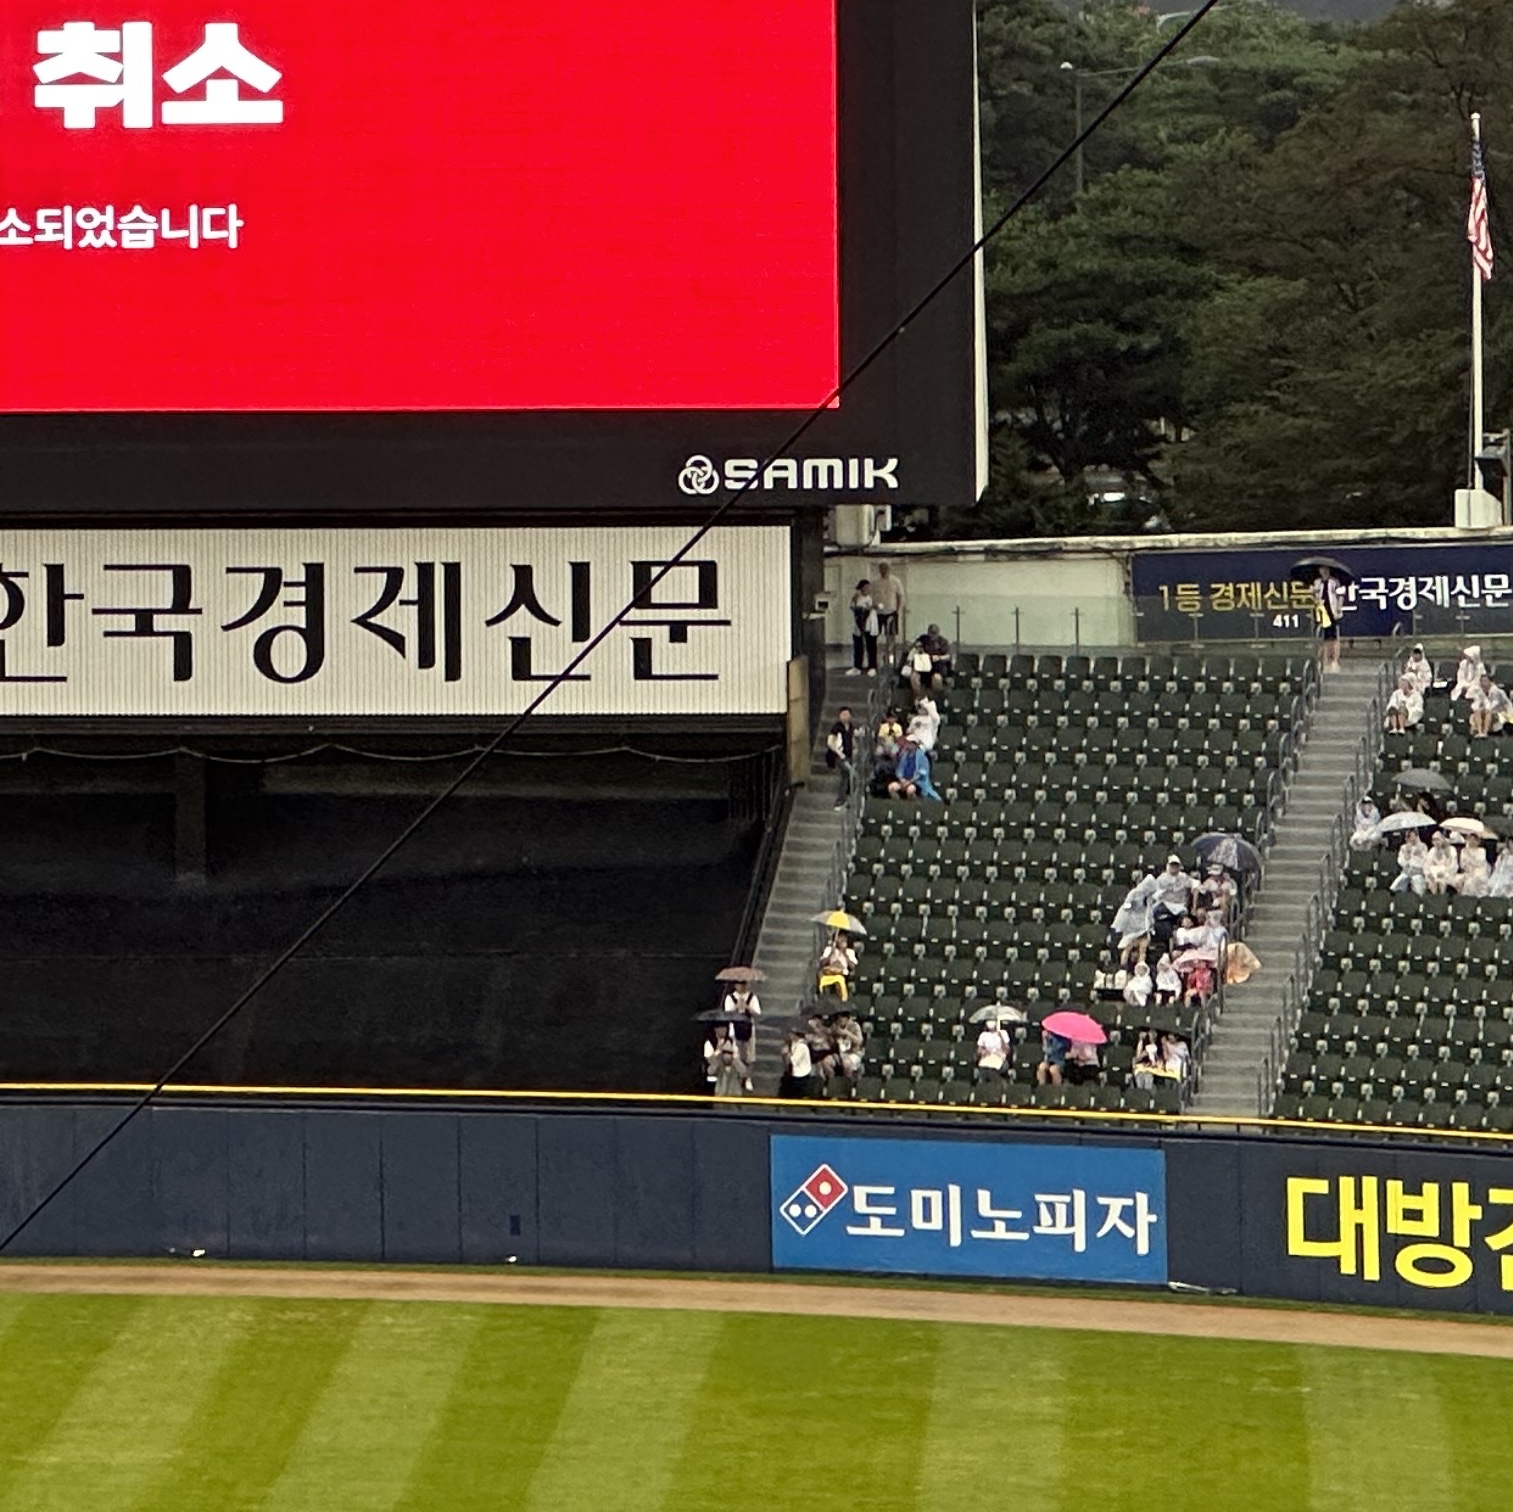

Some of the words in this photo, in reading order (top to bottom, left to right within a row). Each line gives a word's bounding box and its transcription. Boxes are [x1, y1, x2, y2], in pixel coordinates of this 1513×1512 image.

[33, 22, 283, 129] 취소
[724, 458, 899, 489] SAMIK
[1160, 584, 1200, 611] 1등
[1210, 581, 1316, 610] 경제신문
[1273, 614, 1299, 628] 411
[845, 1180, 1157, 1255] 도미노피자
